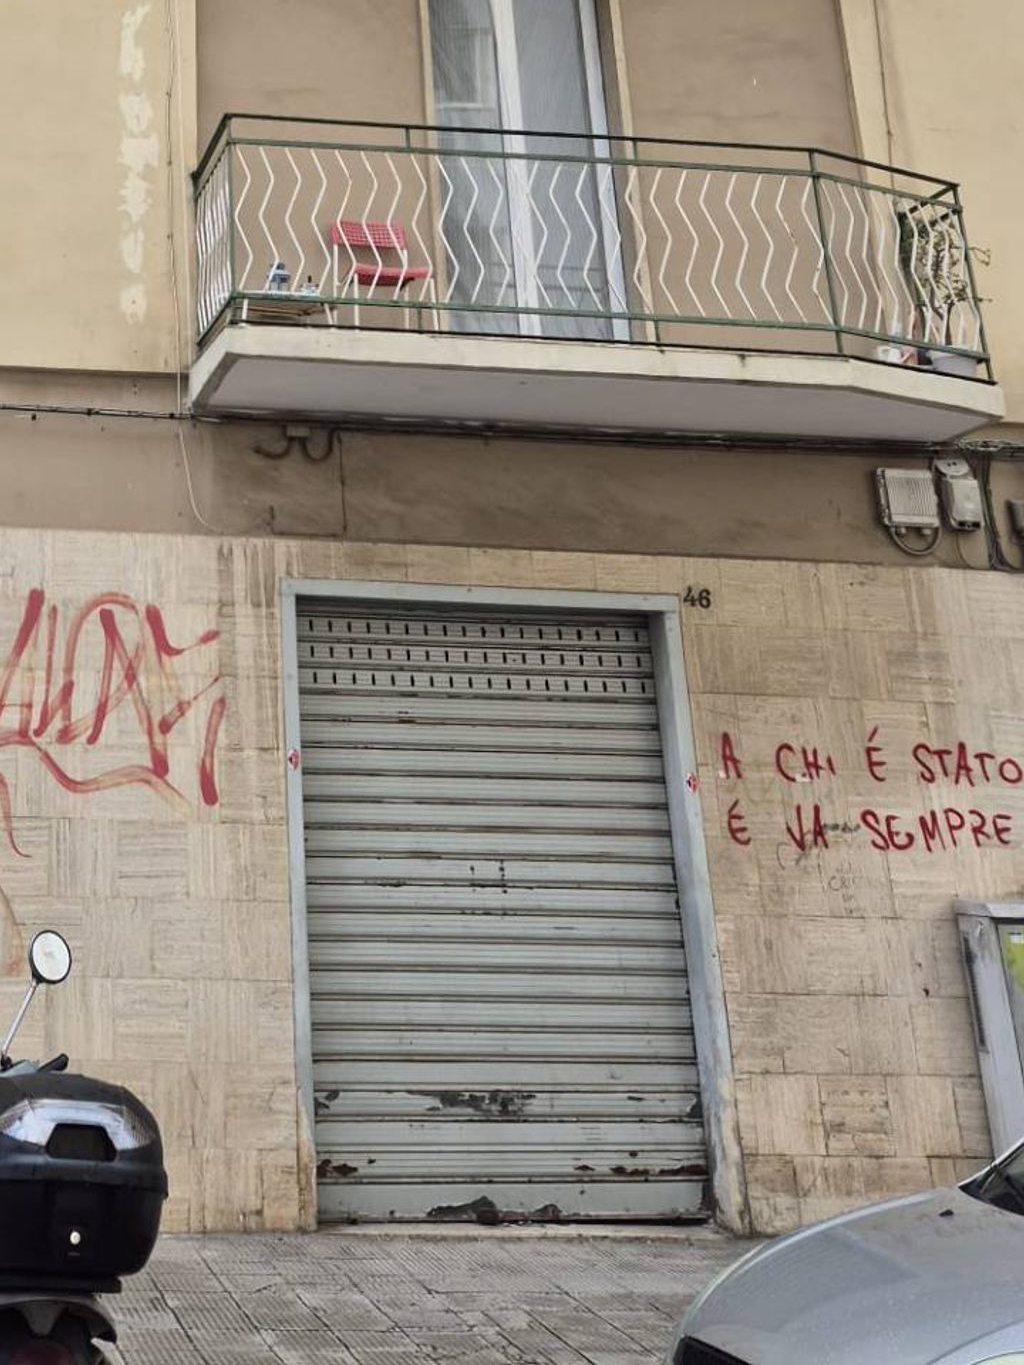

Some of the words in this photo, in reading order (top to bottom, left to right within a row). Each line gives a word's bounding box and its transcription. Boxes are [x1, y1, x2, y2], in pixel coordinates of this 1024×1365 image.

[683, 587, 712, 609] 46
[721, 731, 742, 779] A
[912, 741, 1023, 786] STATO
[786, 804, 829, 851] VA
[861, 807, 1013, 853] SEMPRE
